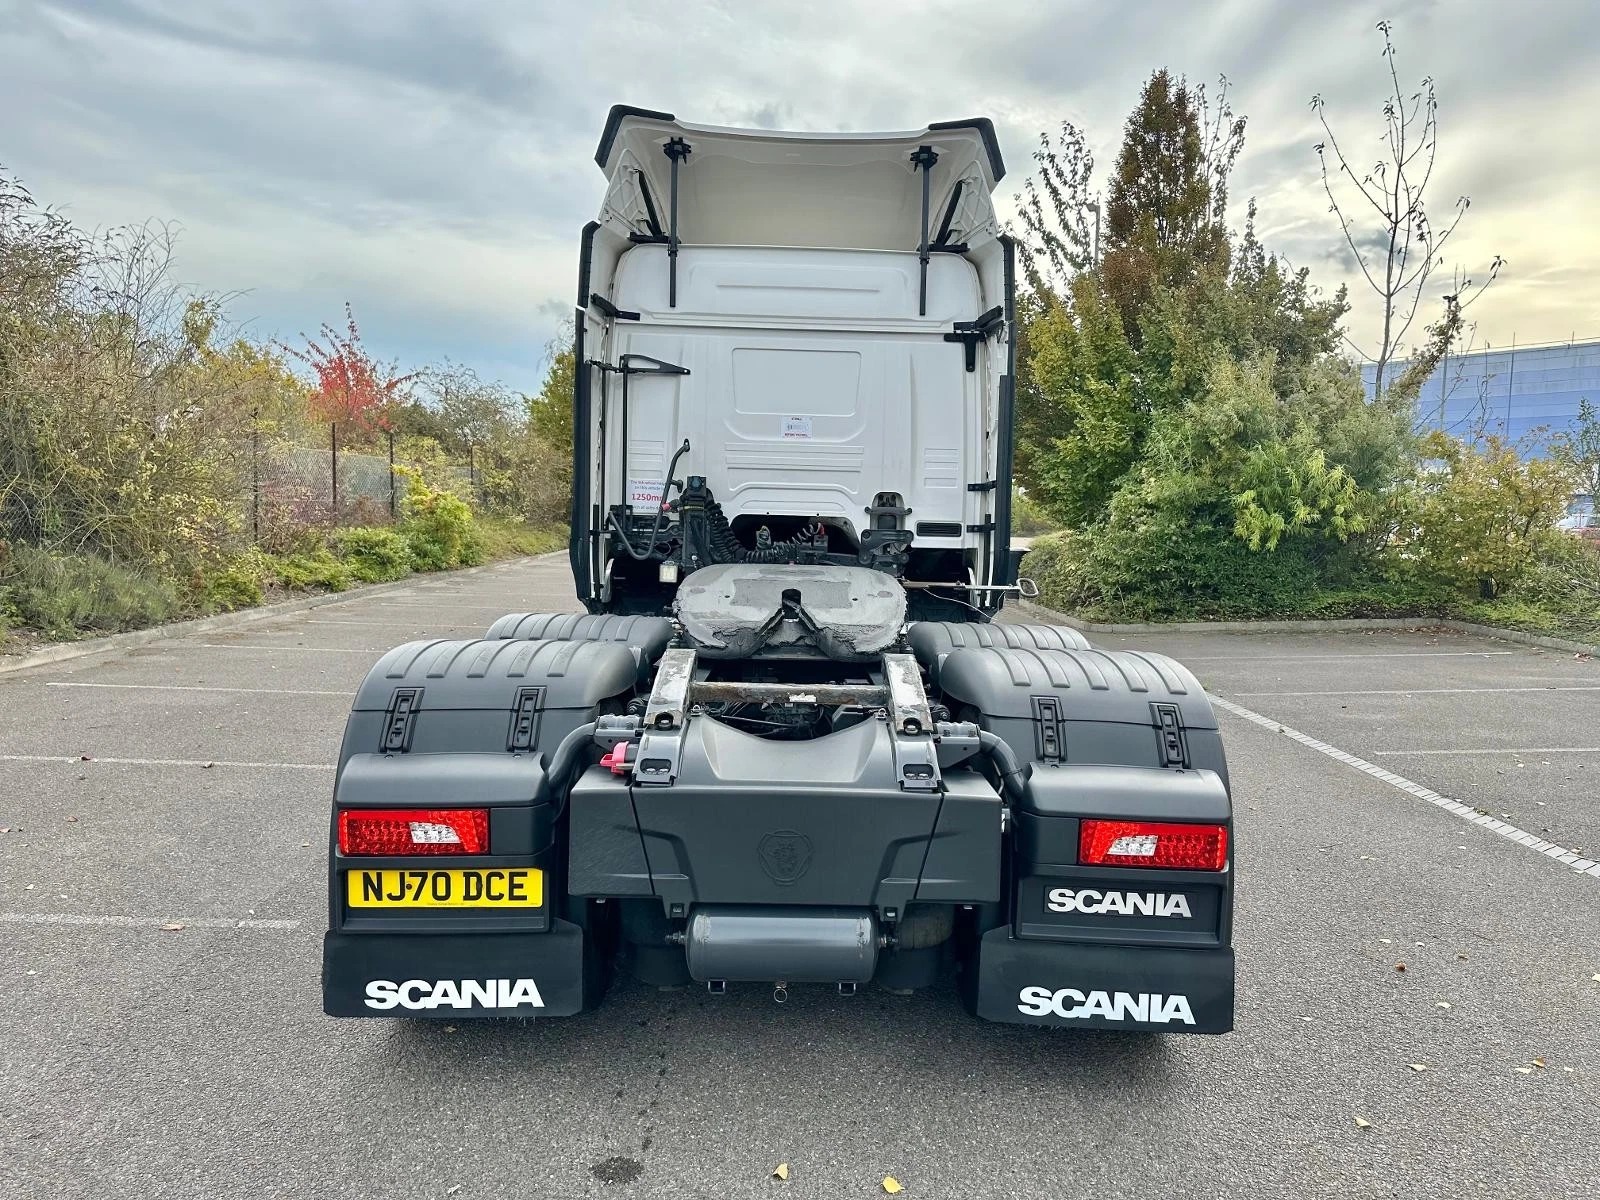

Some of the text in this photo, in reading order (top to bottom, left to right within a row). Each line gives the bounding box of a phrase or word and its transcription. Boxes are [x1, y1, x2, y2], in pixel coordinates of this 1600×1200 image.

[362, 871, 528, 902] NJ70 DCE
[1047, 888, 1192, 918] SCANIA
[364, 978, 545, 1009] SCANIA
[1017, 986, 1196, 1025] SCANIA
